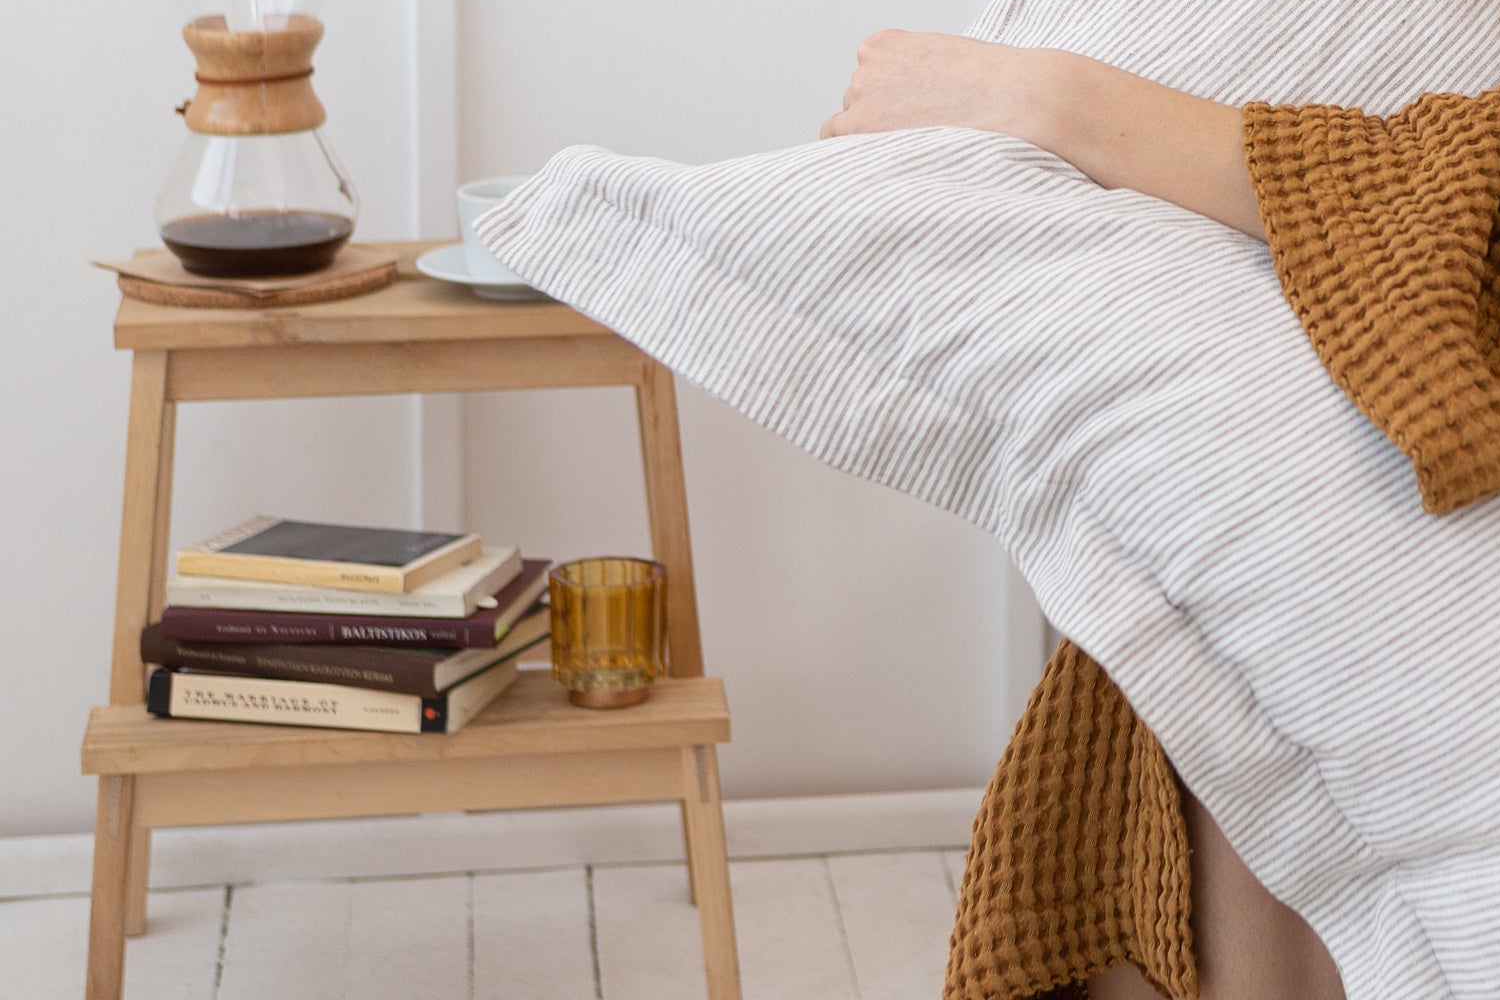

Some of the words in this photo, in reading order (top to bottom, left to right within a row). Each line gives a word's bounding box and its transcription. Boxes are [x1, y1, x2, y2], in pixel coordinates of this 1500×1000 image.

[341, 625, 428, 641] BALTISTIKOS
[184, 688, 215, 699] THE
[224, 691, 308, 706] MARRIAGE
